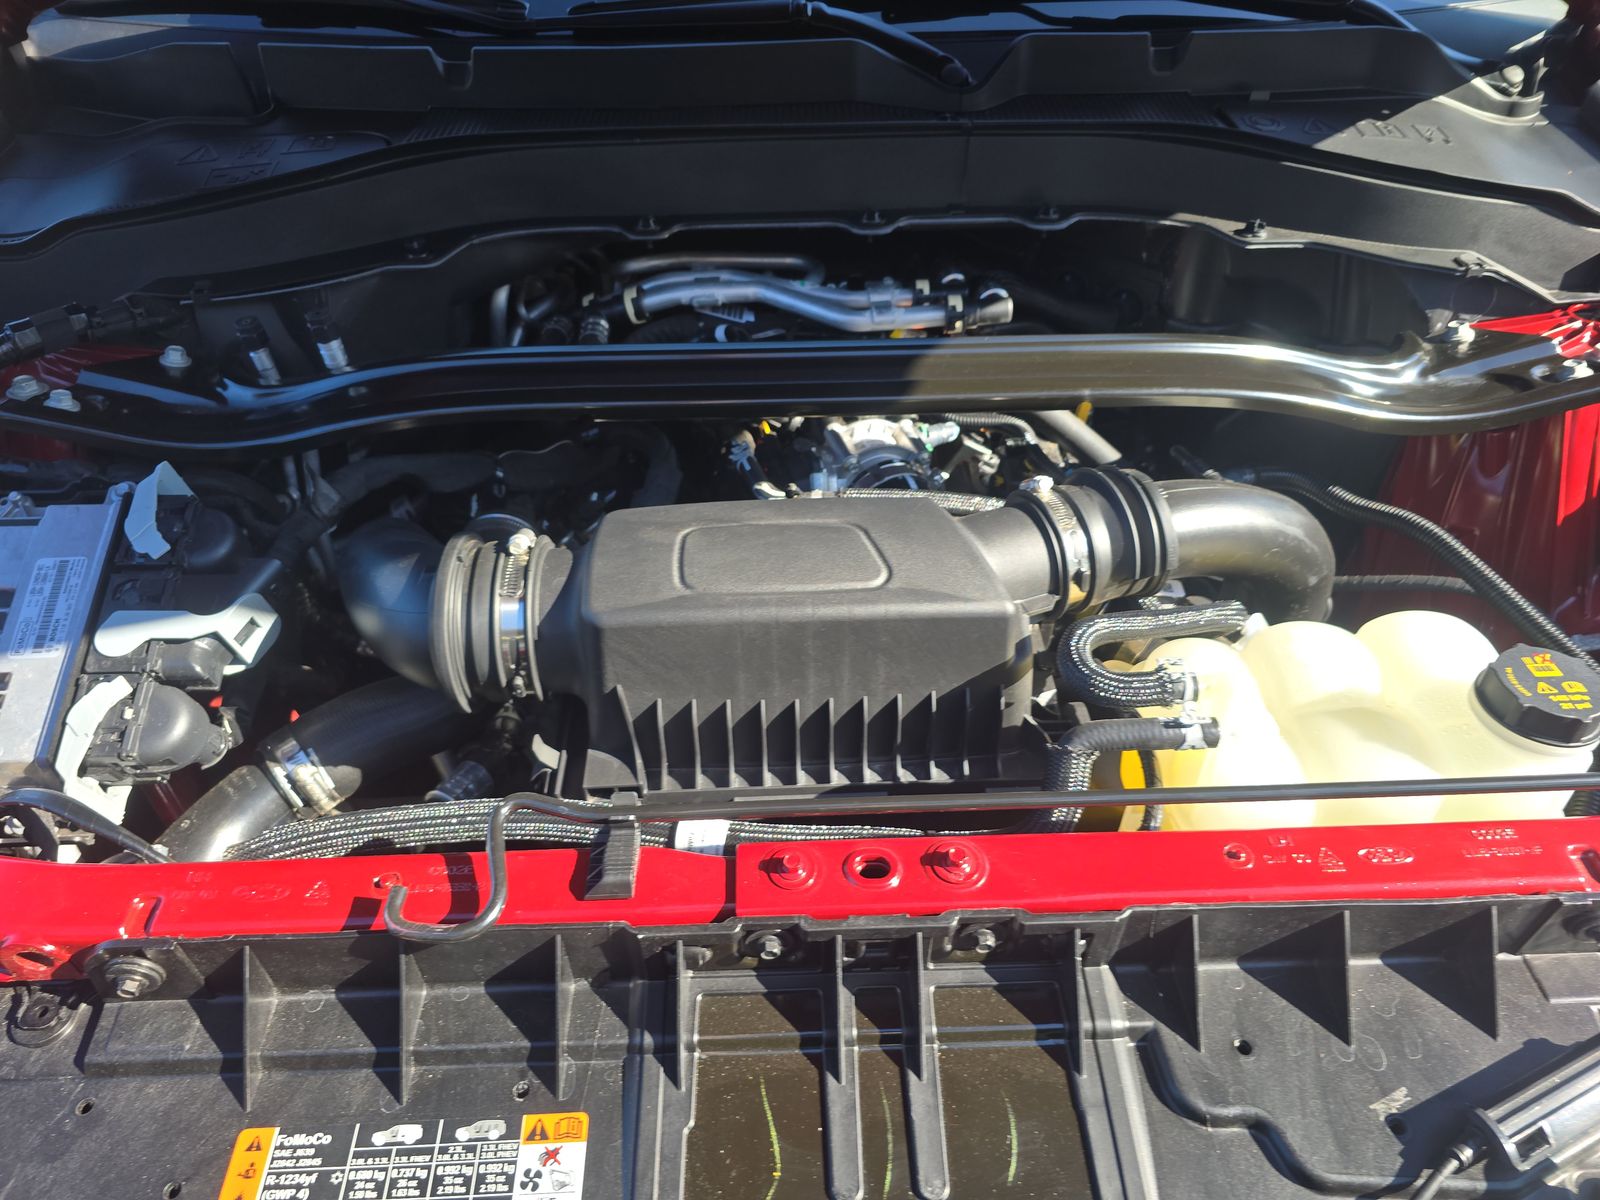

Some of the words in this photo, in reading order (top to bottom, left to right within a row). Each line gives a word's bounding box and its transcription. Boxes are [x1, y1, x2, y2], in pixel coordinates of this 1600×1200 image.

[276, 1132, 332, 1146] FoMoCo
[273, 1149, 293, 1157] SAE
[391, 1168, 416, 1178] 0.737
[415, 1168, 428, 1179] kg
[461, 1165, 474, 1176] kg
[503, 1163, 515, 1174] kg
[266, 1173, 319, 1186] R-1234yf
[373, 1170, 386, 1181] kg
[262, 1190, 296, 1200] (GWP
[296, 1188, 310, 1200] 4)
